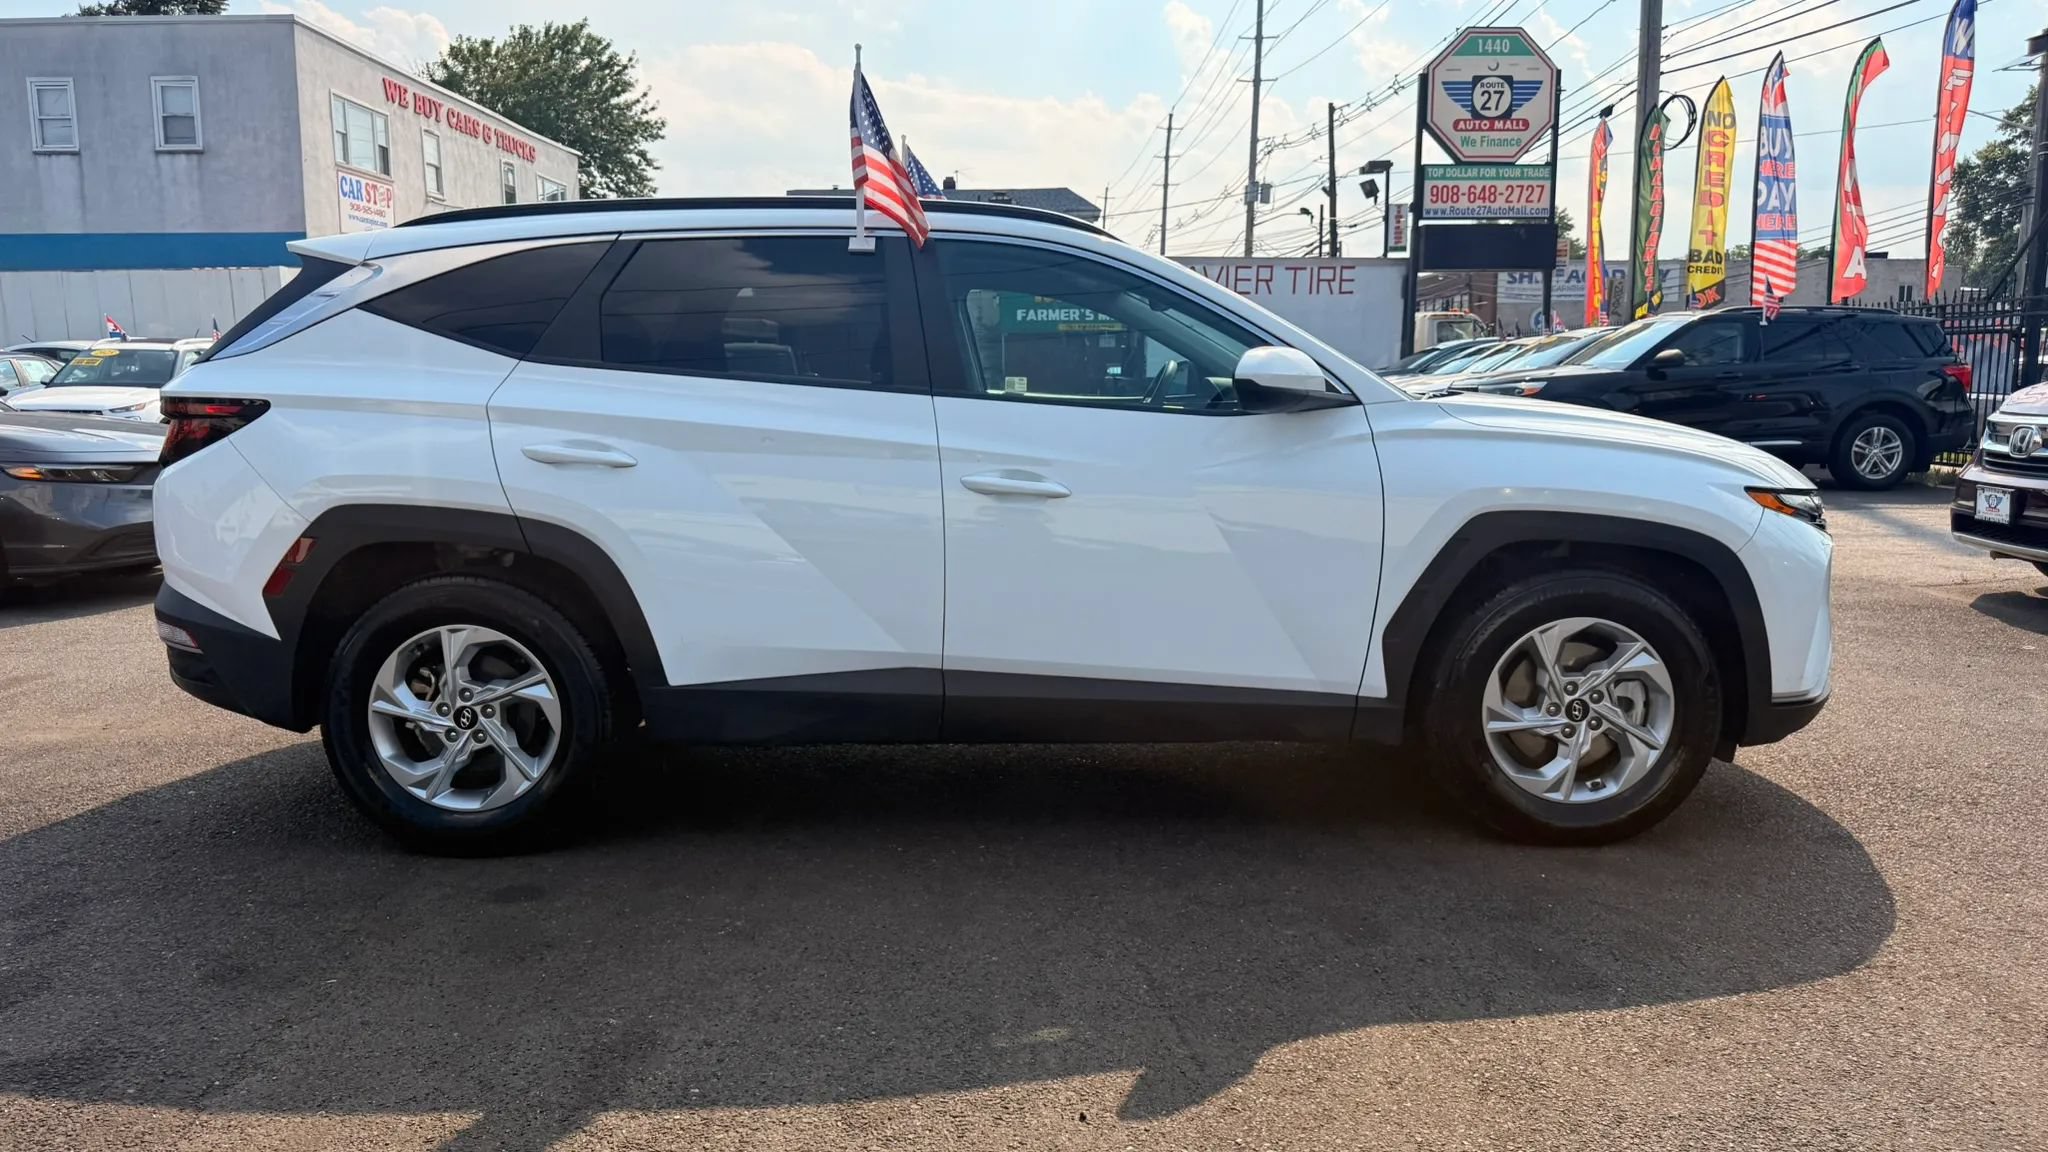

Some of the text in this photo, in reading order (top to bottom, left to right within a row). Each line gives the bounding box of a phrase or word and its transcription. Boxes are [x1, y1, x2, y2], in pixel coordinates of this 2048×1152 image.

[1478, 39, 1510, 53] 1440
[1479, 90, 1505, 111] 27
[383, 77, 410, 109] WE
[413, 92, 444, 123] BUY
[446, 107, 480, 139] CARS
[494, 128, 537, 164] TRUCKS
[1457, 120, 1526, 130] AUTO MALL
[1707, 110, 1736, 129] NO
[1460, 135, 1522, 148] We Finance
[1760, 125, 1793, 159] BUY
[1428, 167, 1550, 177] TOP DOLLAR FOR YOUR TRADE
[340, 175, 364, 202] CAR
[1430, 184, 1545, 204] 908-648-2727
[1698, 130, 1730, 246] CREDIT
[1424, 205, 1549, 217] www.Route27AutoMall.com
[1689, 248, 1723, 264] BAD
[1285, 265, 1356, 295] TIRE
[1016, 308, 1095, 321] FARMER'S
